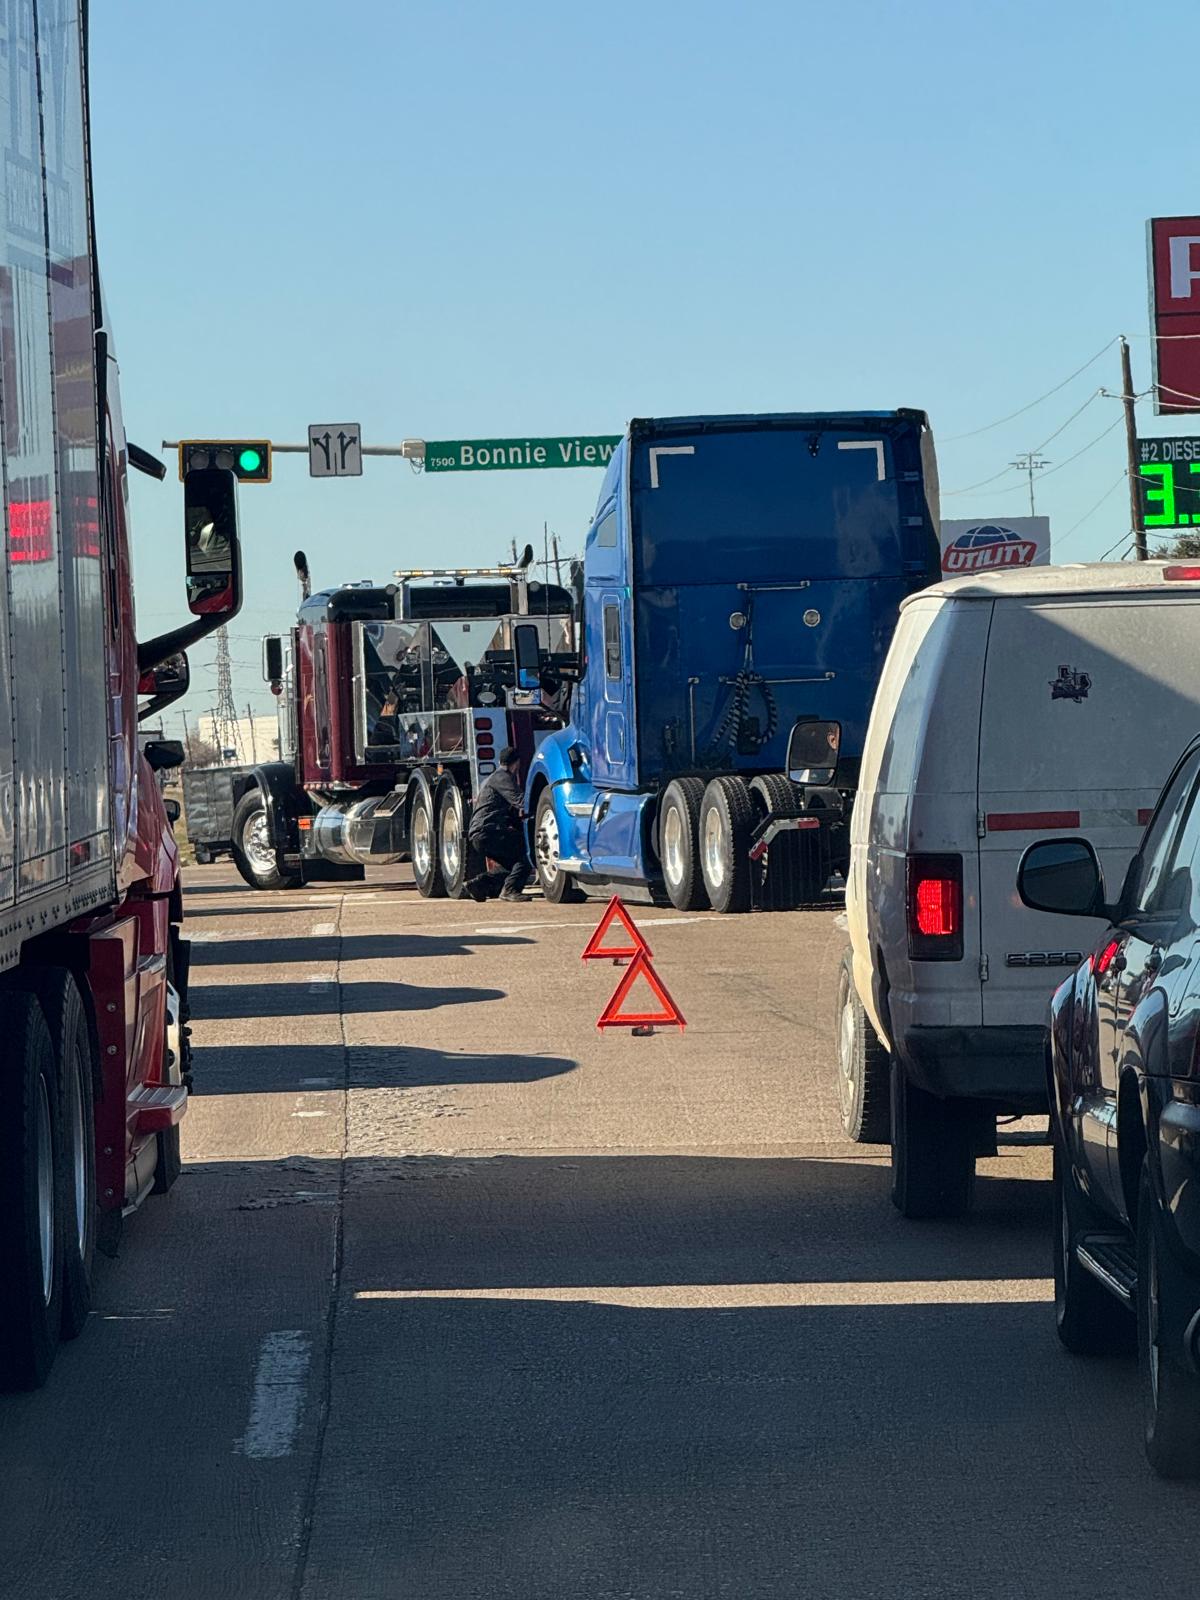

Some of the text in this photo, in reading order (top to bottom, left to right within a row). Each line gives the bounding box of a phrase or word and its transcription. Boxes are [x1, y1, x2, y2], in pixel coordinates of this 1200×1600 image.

[431, 440, 616, 466] 7500 Bonnie View
[1141, 442, 1159, 461] #2
[947, 545, 1031, 568] UTILITY
